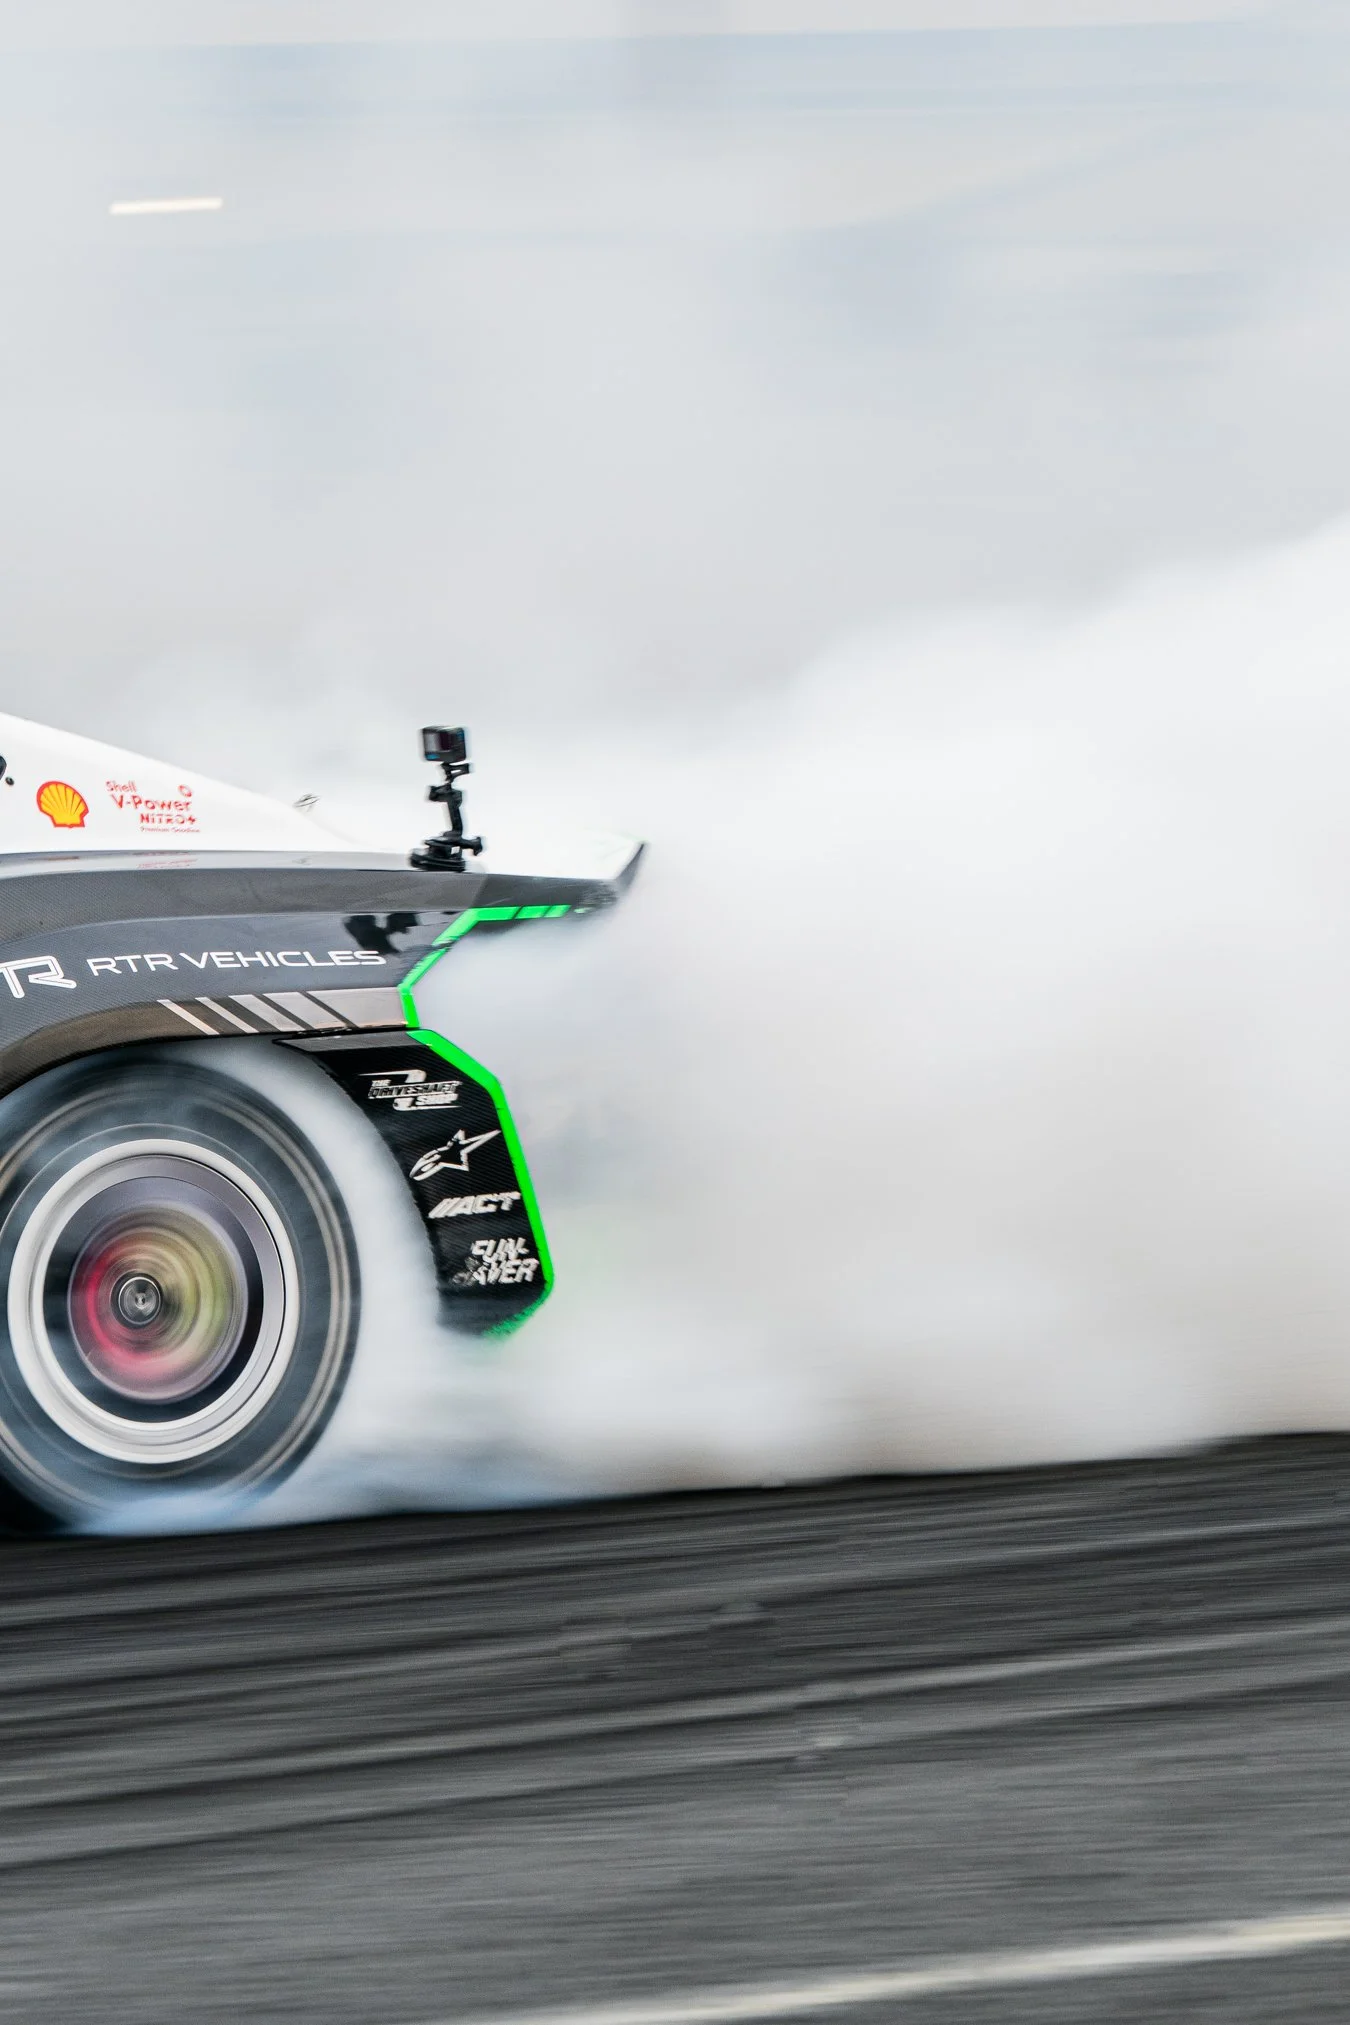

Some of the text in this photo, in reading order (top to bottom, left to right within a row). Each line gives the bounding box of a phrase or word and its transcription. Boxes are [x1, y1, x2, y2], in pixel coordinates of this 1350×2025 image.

[106, 780, 137, 793] Shell
[111, 794, 192, 811] V-Power
[86, 950, 387, 977] RTR VEHICLES
